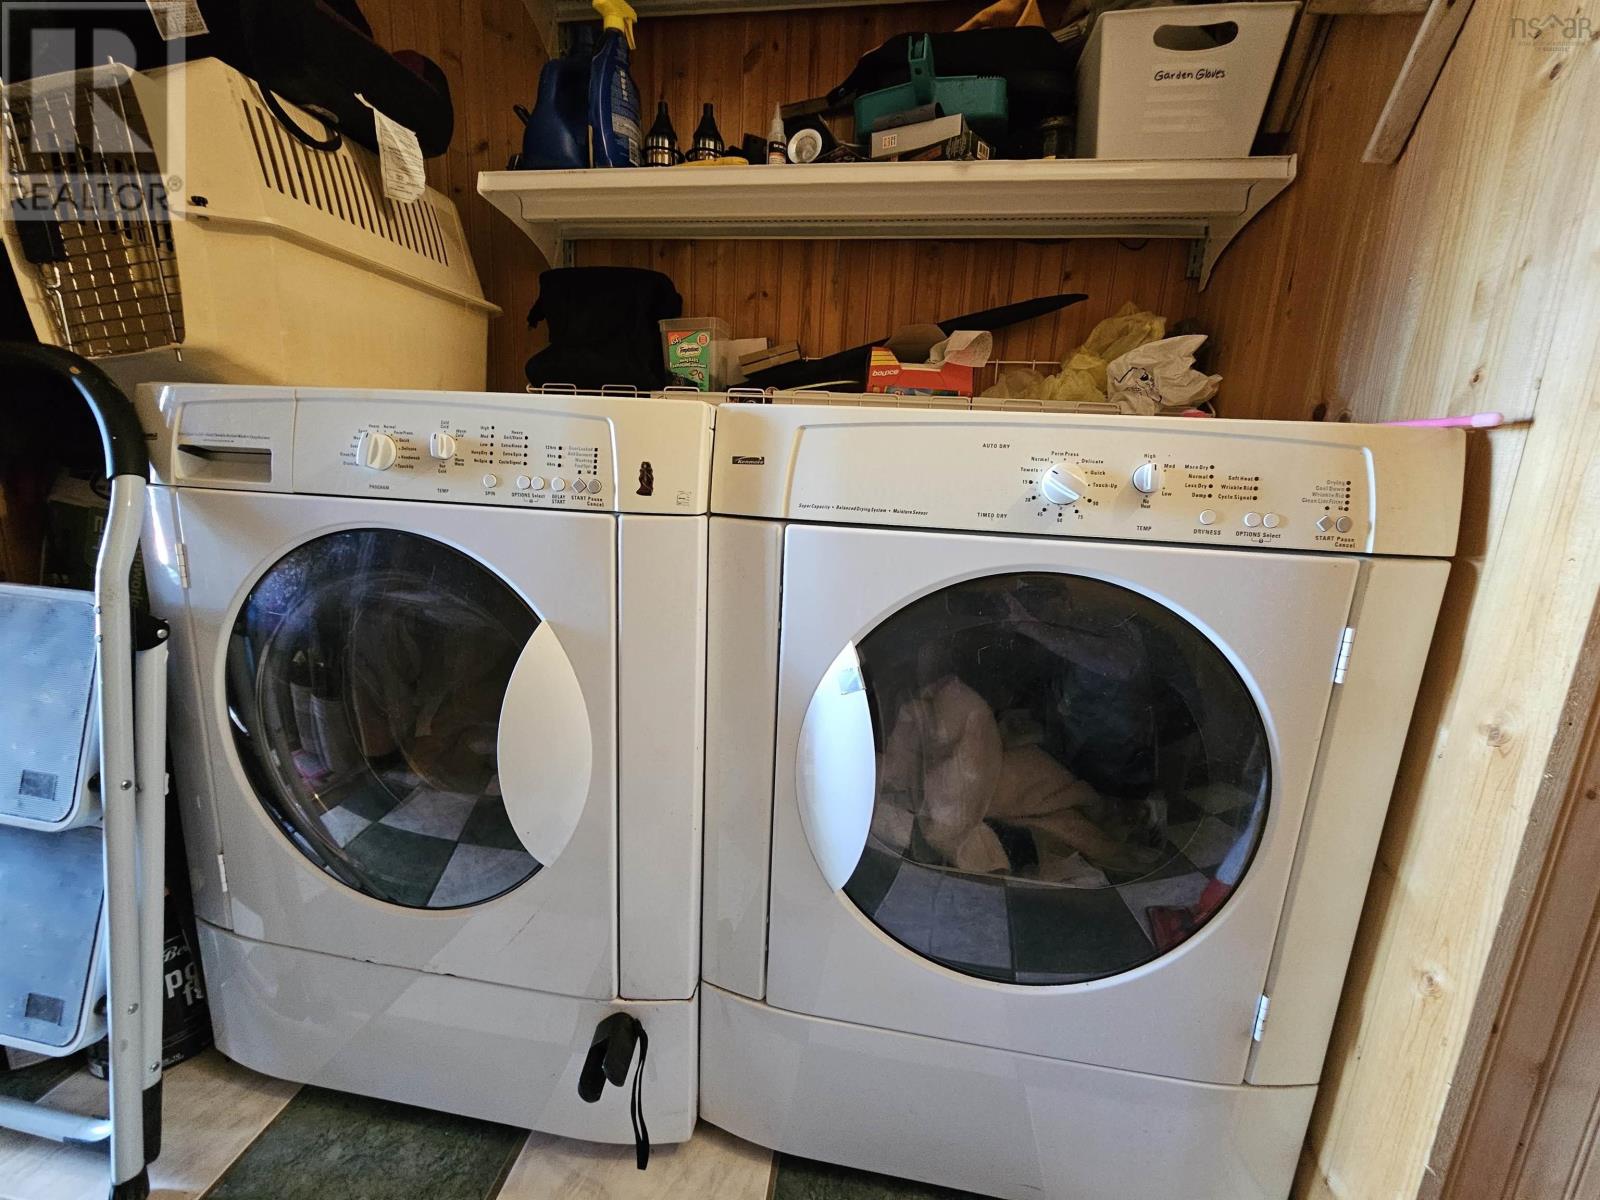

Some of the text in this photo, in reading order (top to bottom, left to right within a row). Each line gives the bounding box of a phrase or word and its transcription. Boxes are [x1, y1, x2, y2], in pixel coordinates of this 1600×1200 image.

[1154, 68, 1226, 81] Garden Gloves
[872, 369, 899, 377] bounce
